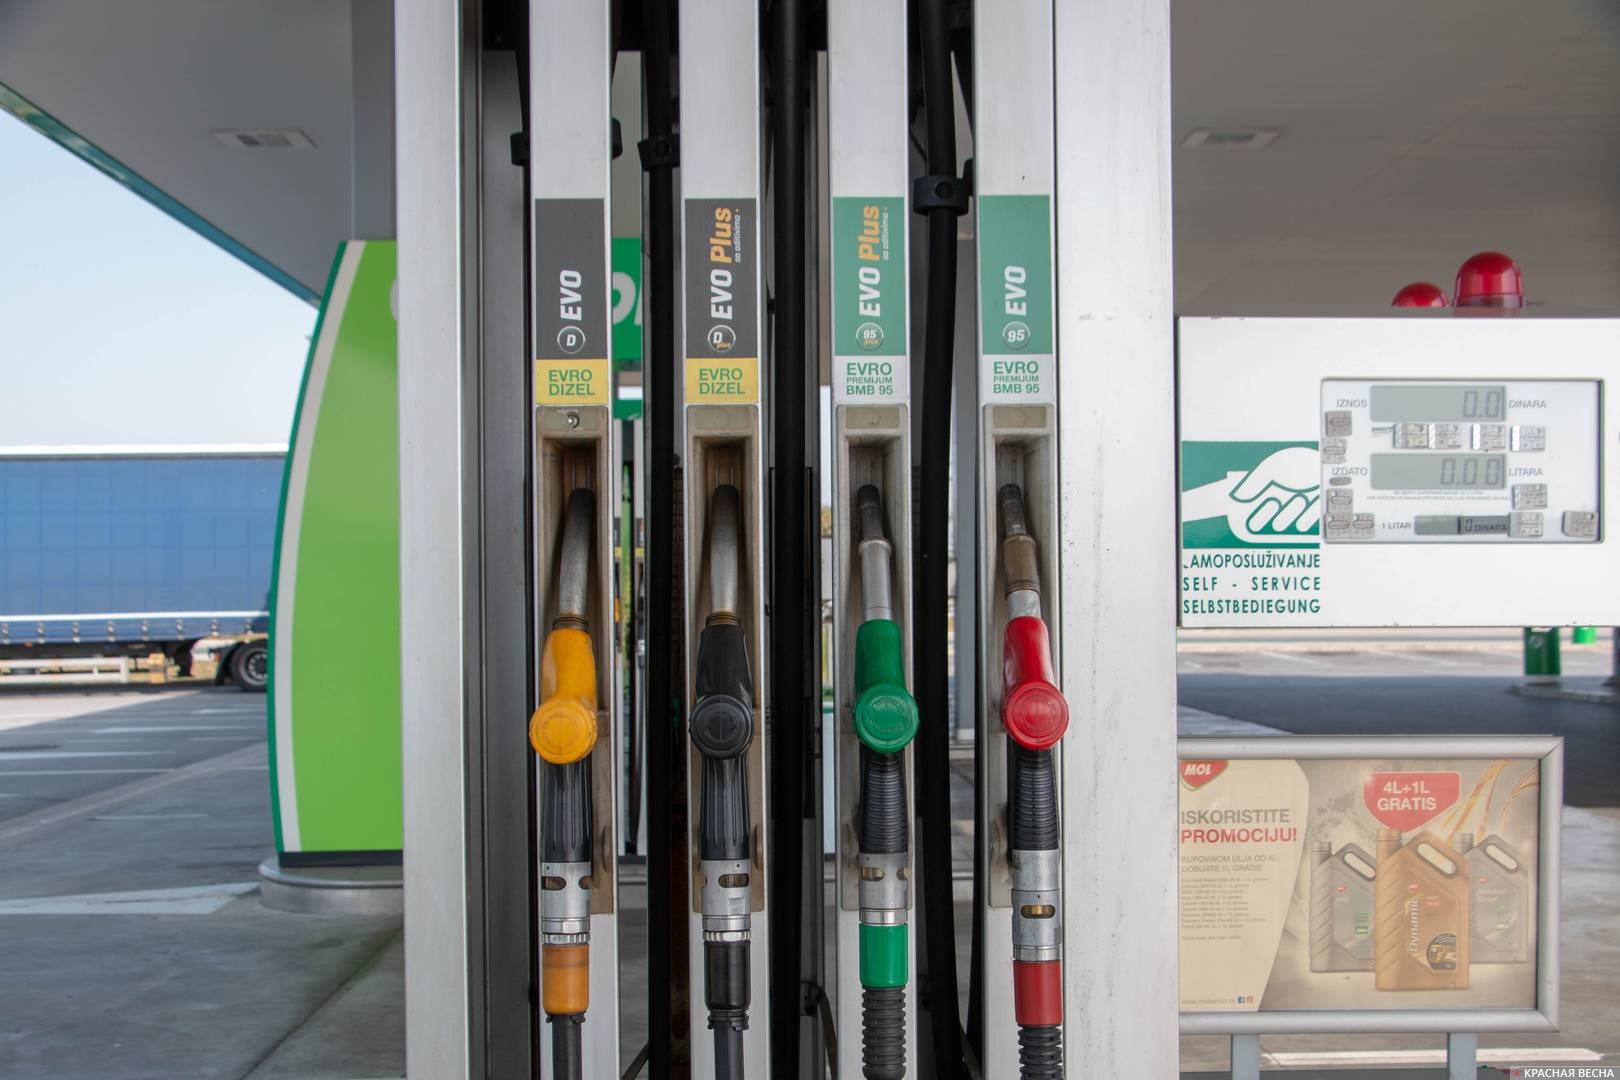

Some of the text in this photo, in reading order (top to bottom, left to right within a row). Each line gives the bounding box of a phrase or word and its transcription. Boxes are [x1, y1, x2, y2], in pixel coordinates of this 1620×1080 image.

[710, 207, 733, 320] EVO Plus
[858, 205, 880, 317] EVO Plus
[560, 270, 582, 320] EVO
[1005, 265, 1027, 316] EVO
[566, 334, 576, 347] D
[713, 331, 722, 344] D
[863, 329, 877, 339] 95
[1008, 329, 1025, 342] 95
[699, 367, 743, 381] EVRO
[847, 362, 893, 376] EVRO
[993, 361, 1039, 374] EVRO
[548, 369, 593, 382] EVRO
[847, 376, 893, 384] PREMIJUM
[993, 375, 1039, 383] PREMIJUM
[549, 383, 595, 396] DIZEL
[699, 381, 746, 395] DIZEL
[846, 385, 893, 395] BMB 95
[993, 383, 1040, 394] BMB 95
[1336, 399, 1368, 408] IZNOS
[1462, 390, 1500, 418] 0.0
[1508, 399, 1547, 409] DINARA
[1331, 467, 1368, 476] IZDATO
[1440, 458, 1500, 486] 0.00
[1508, 467, 1543, 477] LITARA
[1388, 522, 1411, 530] LITAR
[1474, 523, 1507, 532] DINARA
[1183, 576, 1218, 591] SELF
[1251, 576, 1321, 591] SERVICE
[1183, 599, 1321, 614] SELBSTBEDIEGUNG
[1184, 763, 1213, 776] MOL
[1383, 780, 1430, 794] 4L+1L
[1376, 797, 1437, 811] GRATIS
[1181, 808, 1290, 825] ISKORISTITE
[1181, 827, 1297, 844] PROMOCIJU!
[1232, 864, 1262, 872] GRATIS
